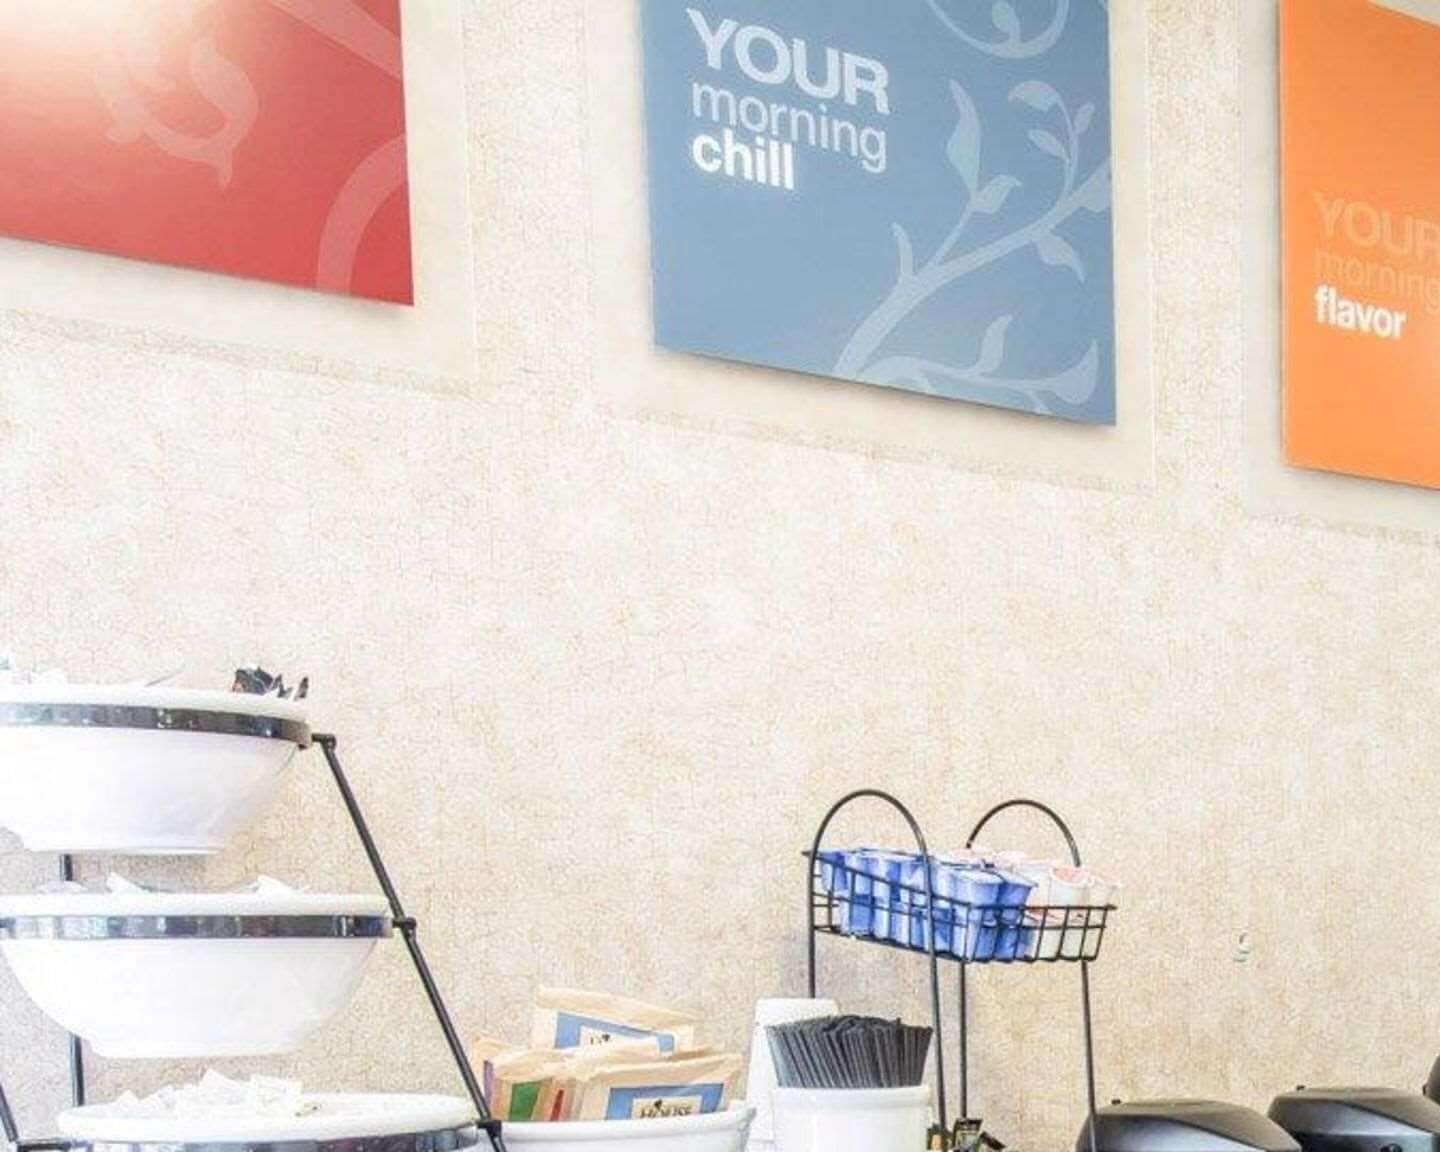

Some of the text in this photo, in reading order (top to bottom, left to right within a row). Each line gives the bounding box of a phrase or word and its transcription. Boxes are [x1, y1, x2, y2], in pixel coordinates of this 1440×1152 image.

[687, 8, 890, 115] YOUR
[692, 82, 887, 173] morning
[692, 129, 795, 190] chill
[1314, 285, 1408, 340] flavor
